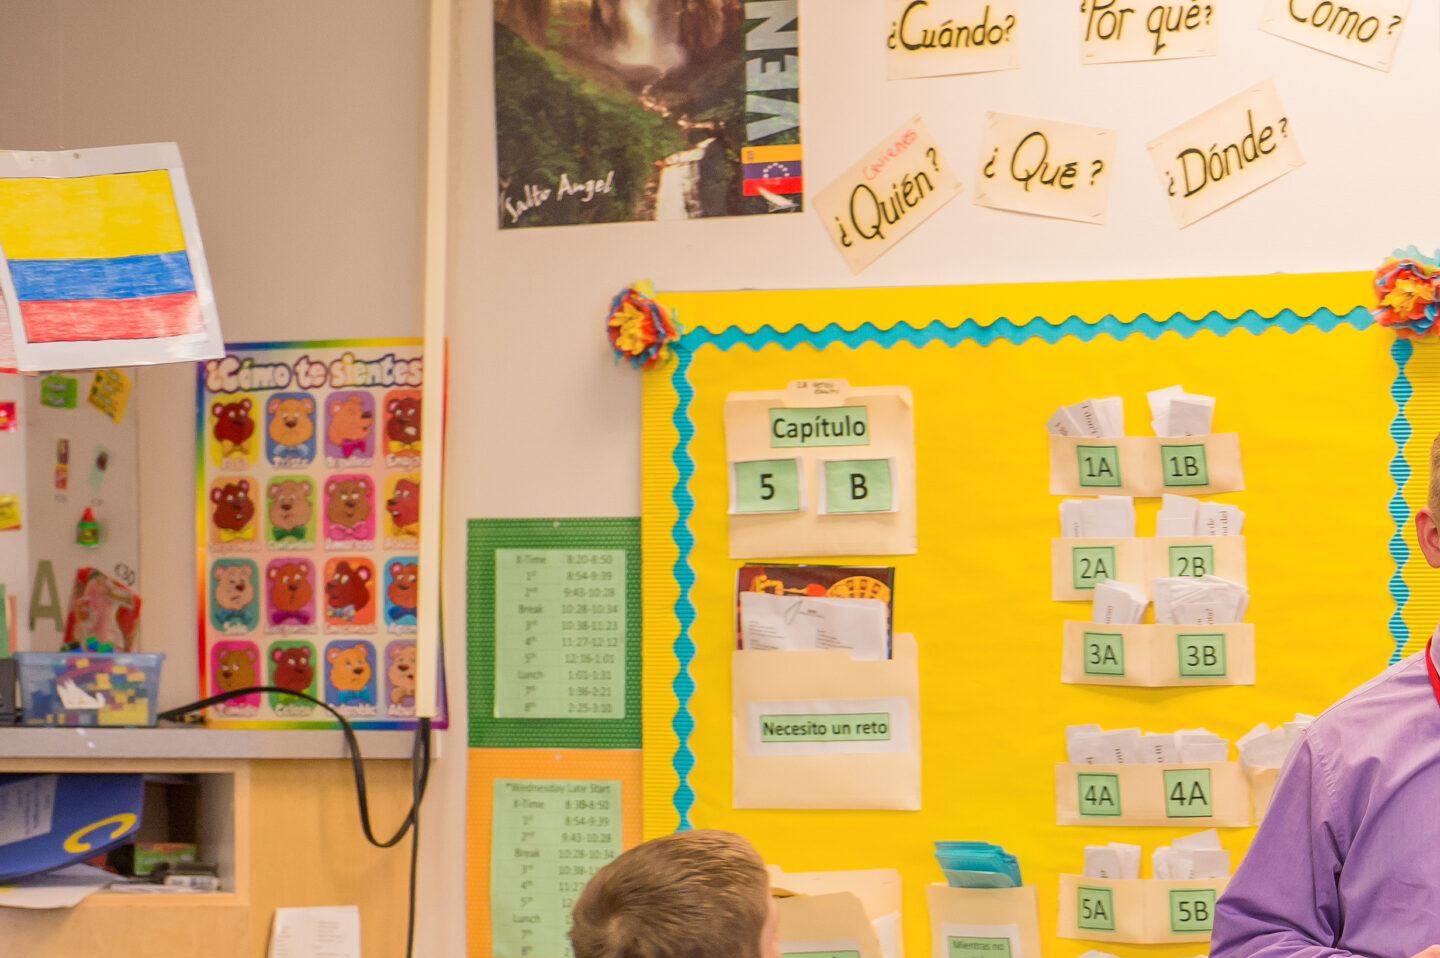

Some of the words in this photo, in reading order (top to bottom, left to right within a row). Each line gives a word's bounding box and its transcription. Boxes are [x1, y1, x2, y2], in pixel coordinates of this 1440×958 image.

[1165, 109, 1288, 198] ¿Dónde?
[294, 354, 328, 389] te
[772, 415, 866, 443] Capítulo
[1084, 456, 1114, 478] 1A
[1169, 456, 1199, 477] 1B
[760, 473, 775, 500] 5
[850, 472, 868, 500] B
[1080, 558, 1109, 579] 2A
[1177, 557, 1207, 578] 2B
[1089, 643, 1118, 666] 3A
[1186, 645, 1217, 667] 3B
[762, 721, 827, 736] Necesito
[832, 723, 851, 736] un
[856, 721, 888, 735] reto
[1084, 785, 1114, 806] 4A
[1170, 781, 1208, 806] 4A
[1081, 898, 1108, 921] 5A
[1178, 900, 1209, 922] 5B
